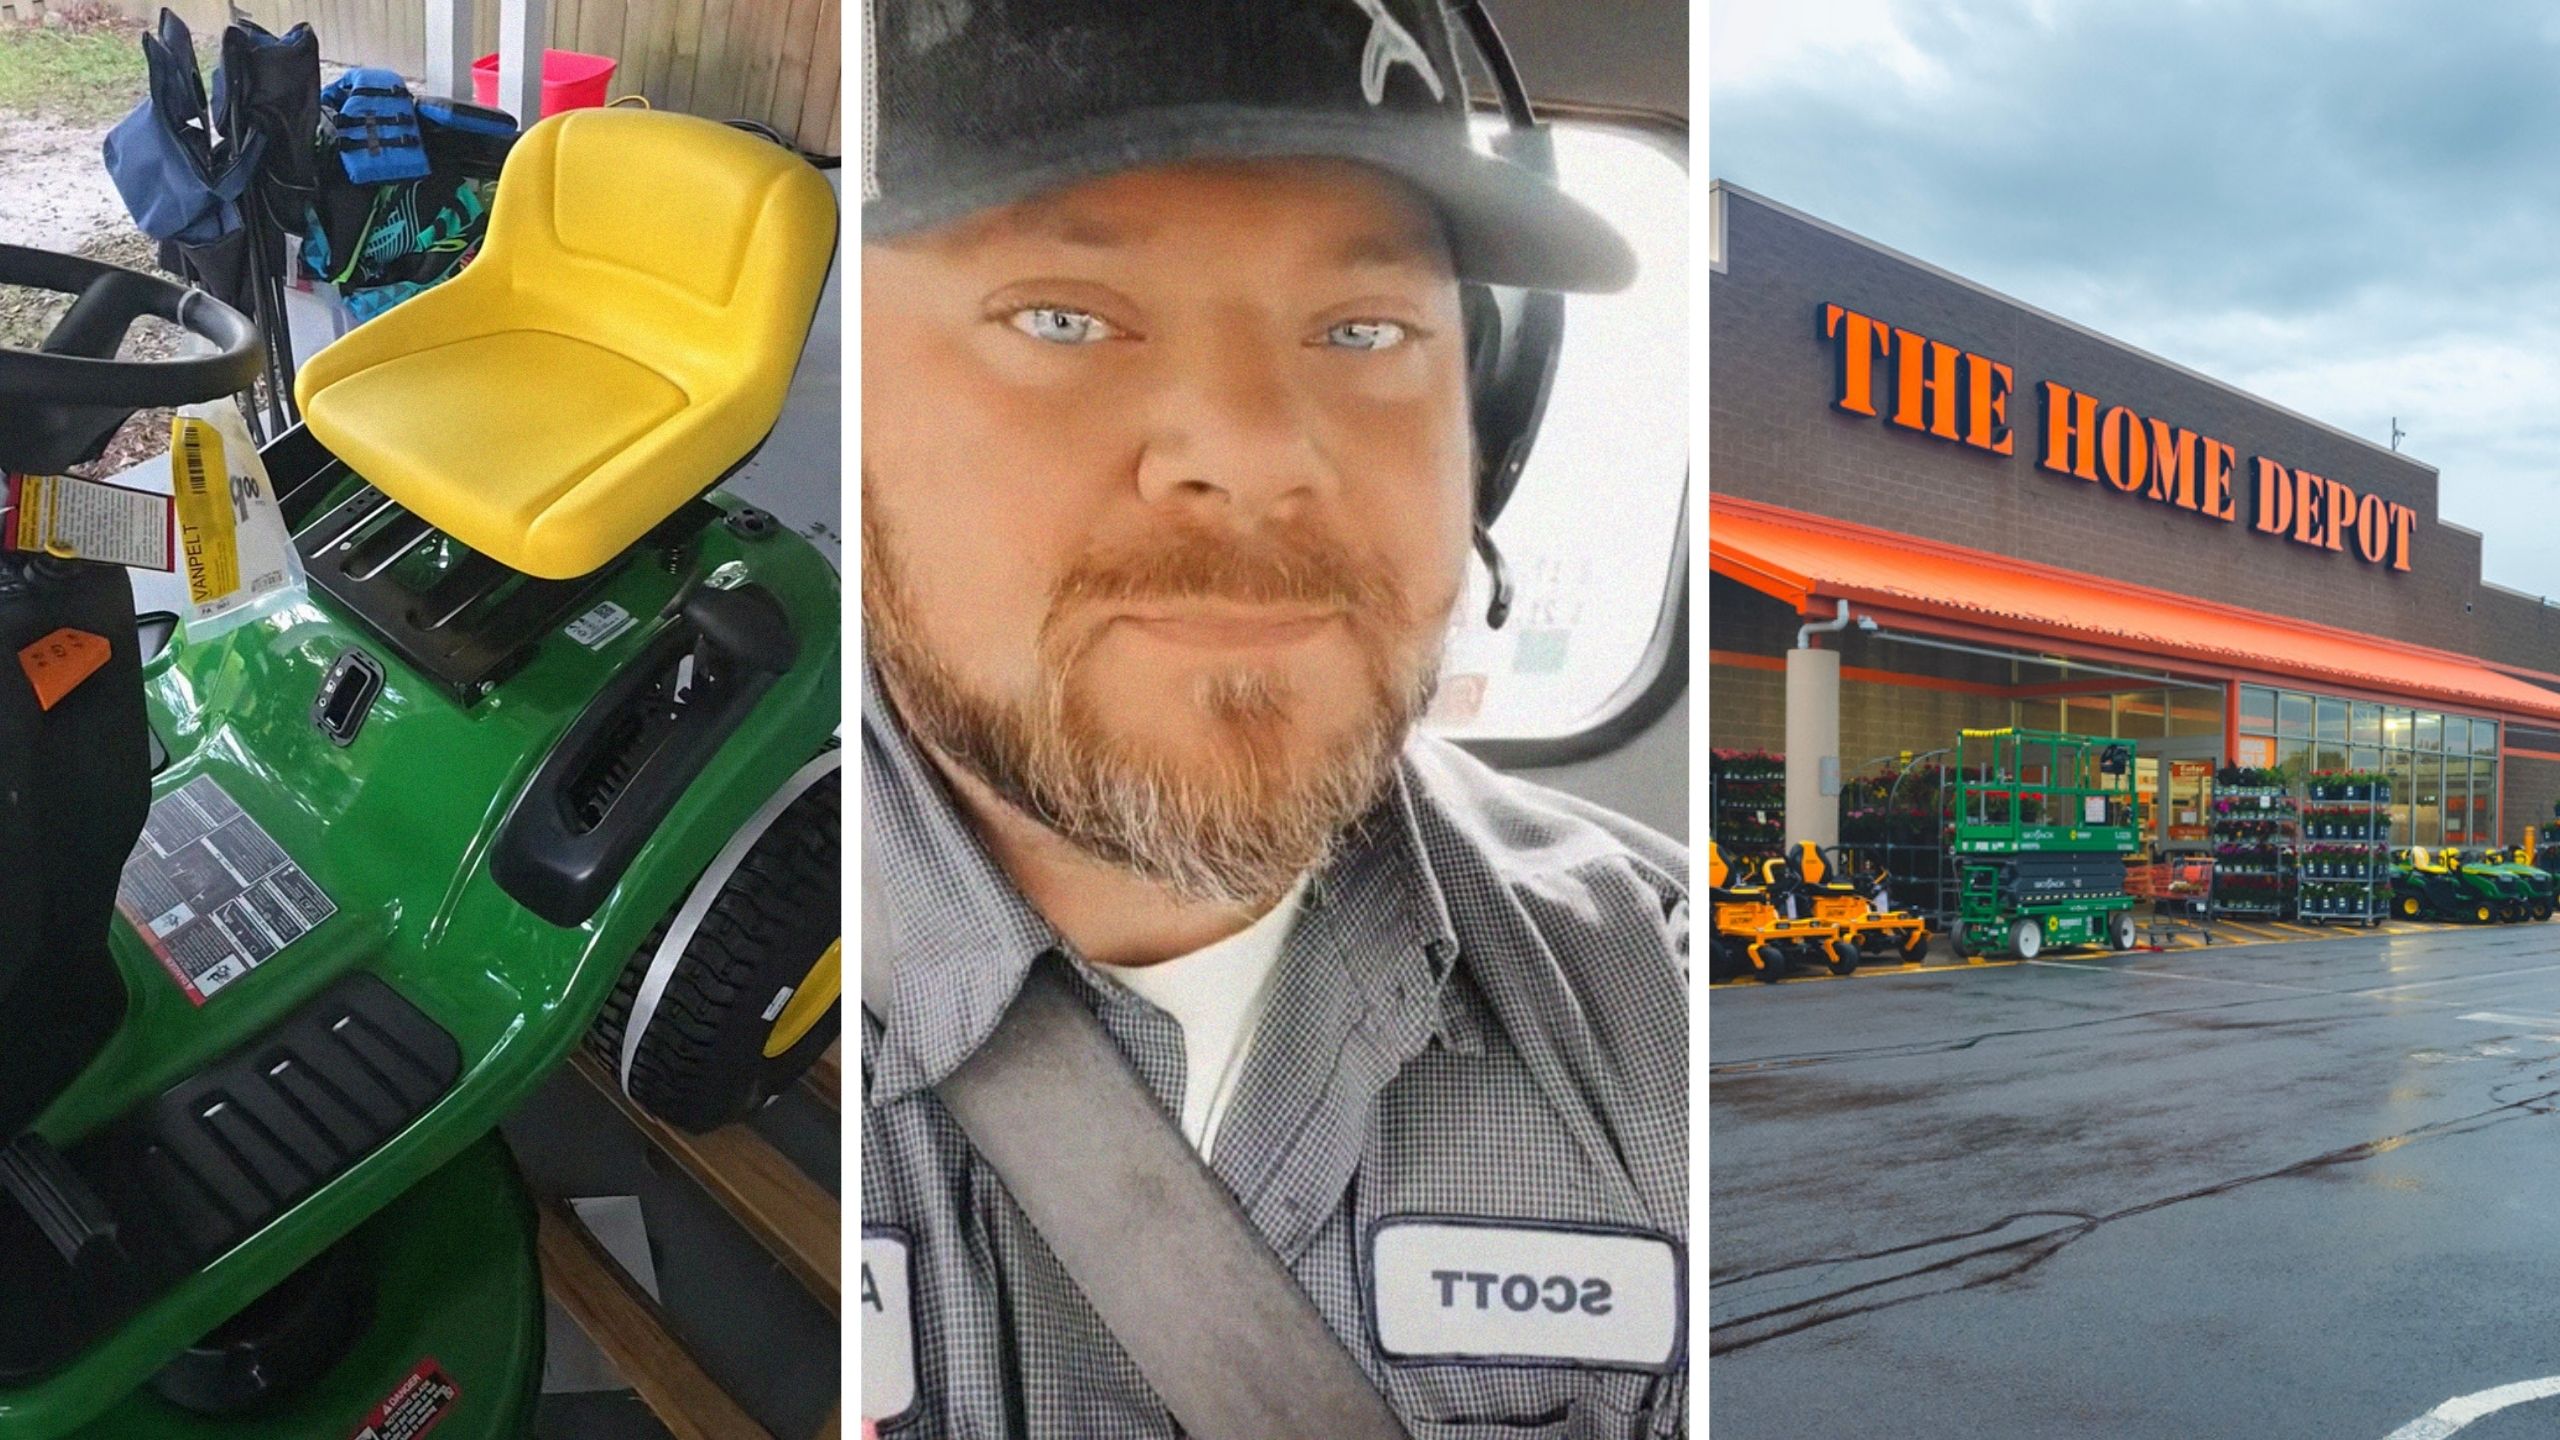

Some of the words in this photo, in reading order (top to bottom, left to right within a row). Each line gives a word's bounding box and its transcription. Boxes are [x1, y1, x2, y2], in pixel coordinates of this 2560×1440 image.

[1822, 301, 2014, 456] THE
[2041, 379, 2236, 522] HOME
[2254, 455, 2417, 571] DEPOT
[182, 523, 209, 601] VANPELT
[388, 1373, 421, 1407] DANGER
